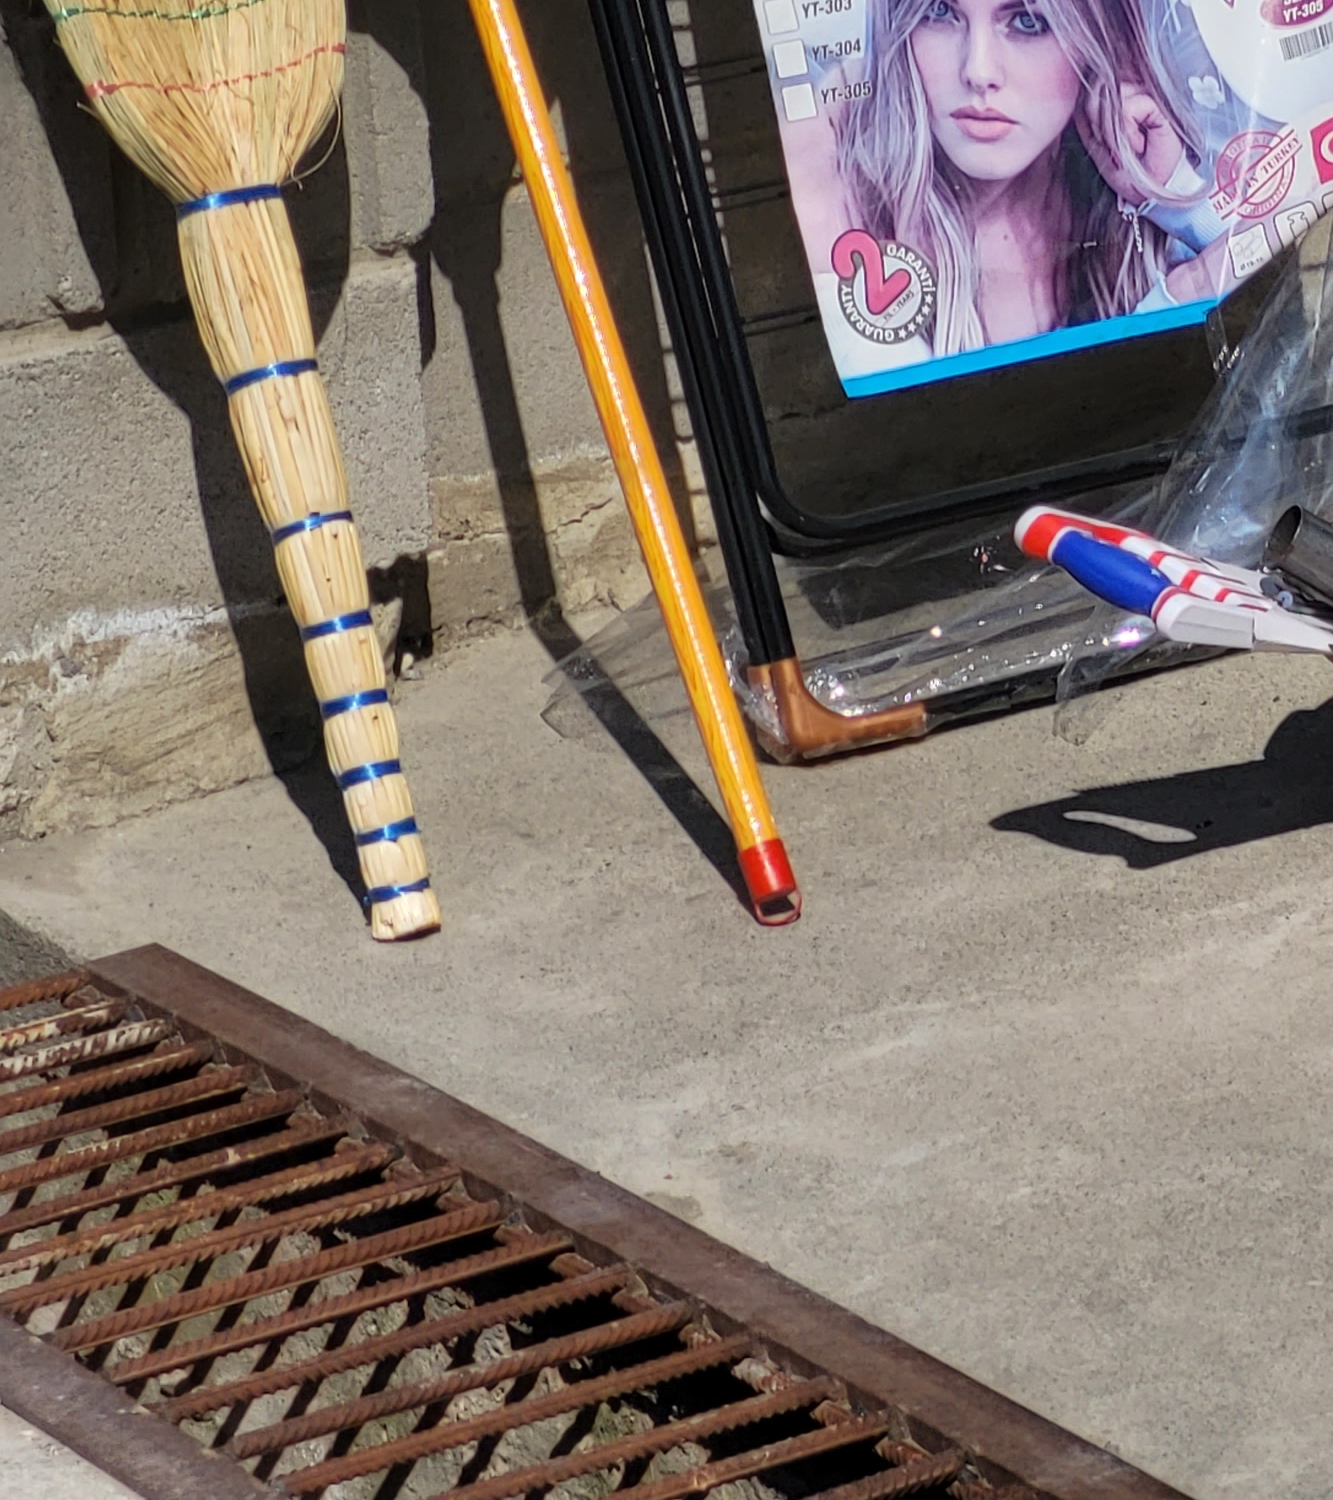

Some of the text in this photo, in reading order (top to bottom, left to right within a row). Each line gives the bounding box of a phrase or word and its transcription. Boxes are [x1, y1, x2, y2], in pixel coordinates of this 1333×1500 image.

[812, 38, 861, 62] YT-304
[821, 81, 871, 104] YT-305
[1260, 134, 1301, 176] TURKEY
